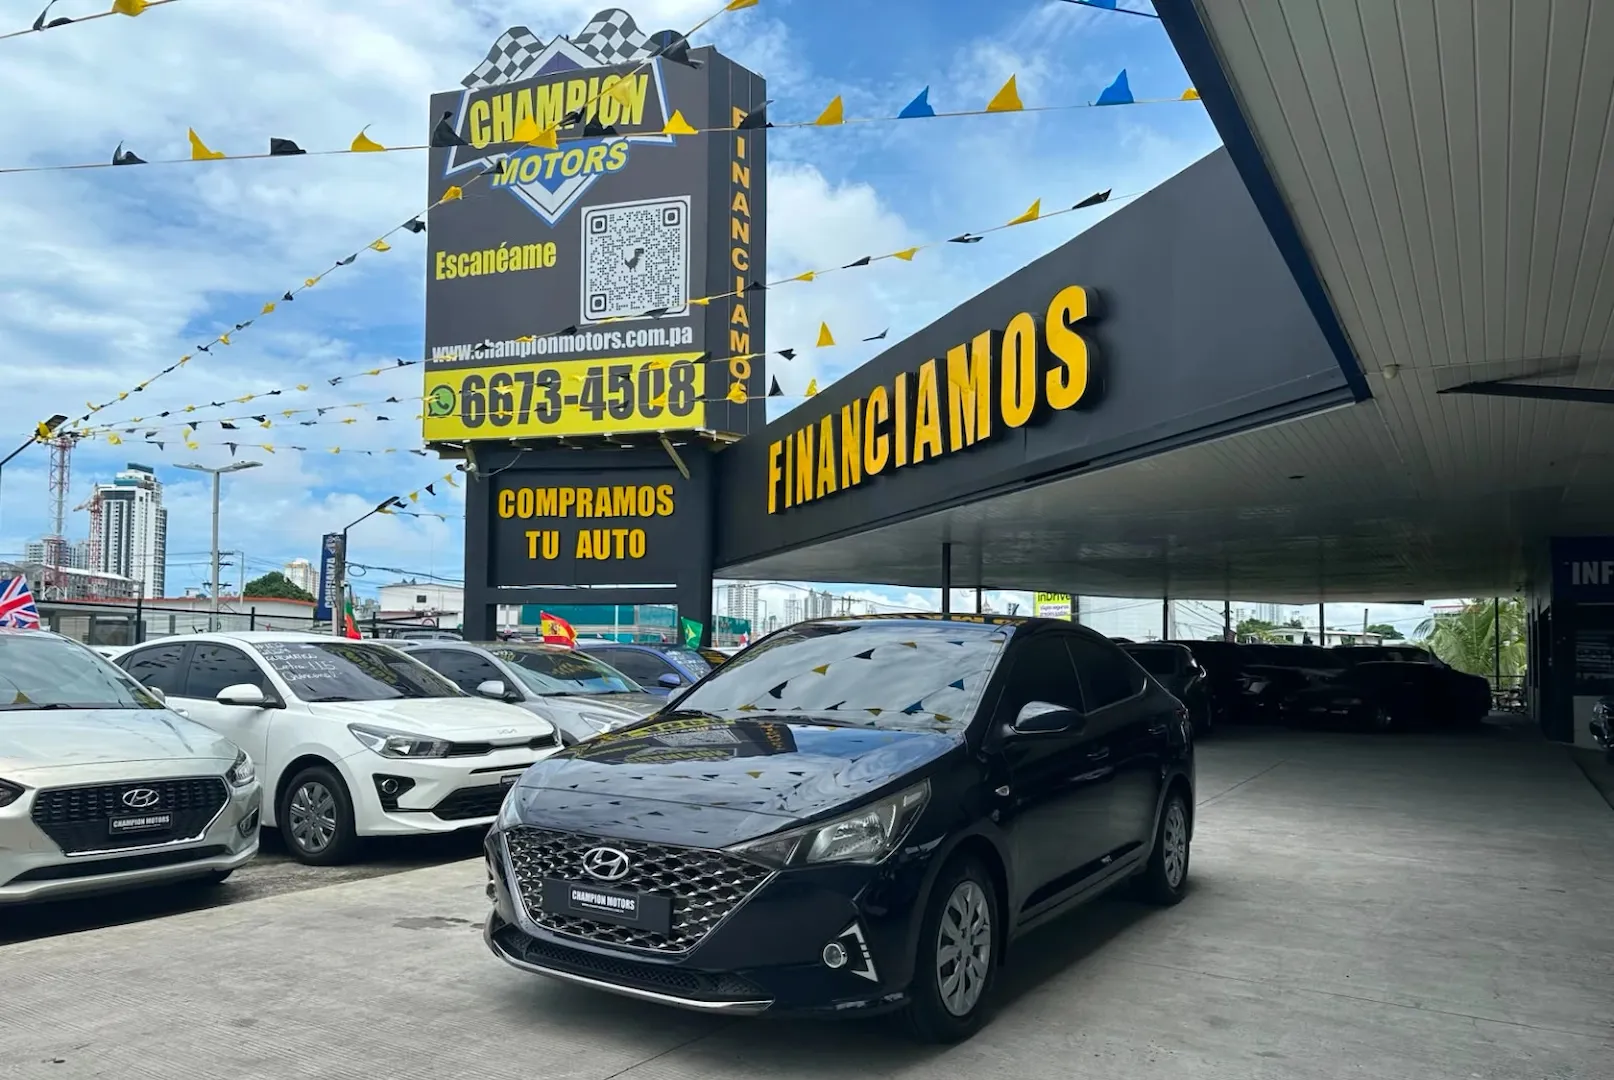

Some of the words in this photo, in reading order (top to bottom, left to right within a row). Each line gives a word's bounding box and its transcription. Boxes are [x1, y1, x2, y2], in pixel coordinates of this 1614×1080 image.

[470, 74, 649, 150] CHAMPION
[492, 142, 629, 187] MOTORS
[435, 241, 557, 281] Escanéame
[432, 326, 693, 364] www.championmotors.com.pa
[460, 359, 696, 429] 6673-4508
[767, 285, 1090, 516] FINANCIAMOS
[498, 484, 675, 519] COMPRAMOS
[525, 530, 560, 560] TU
[576, 529, 647, 560] AUTO
[572, 890, 606, 905] CHAMPION
[607, 896, 635, 910] MOTORS
